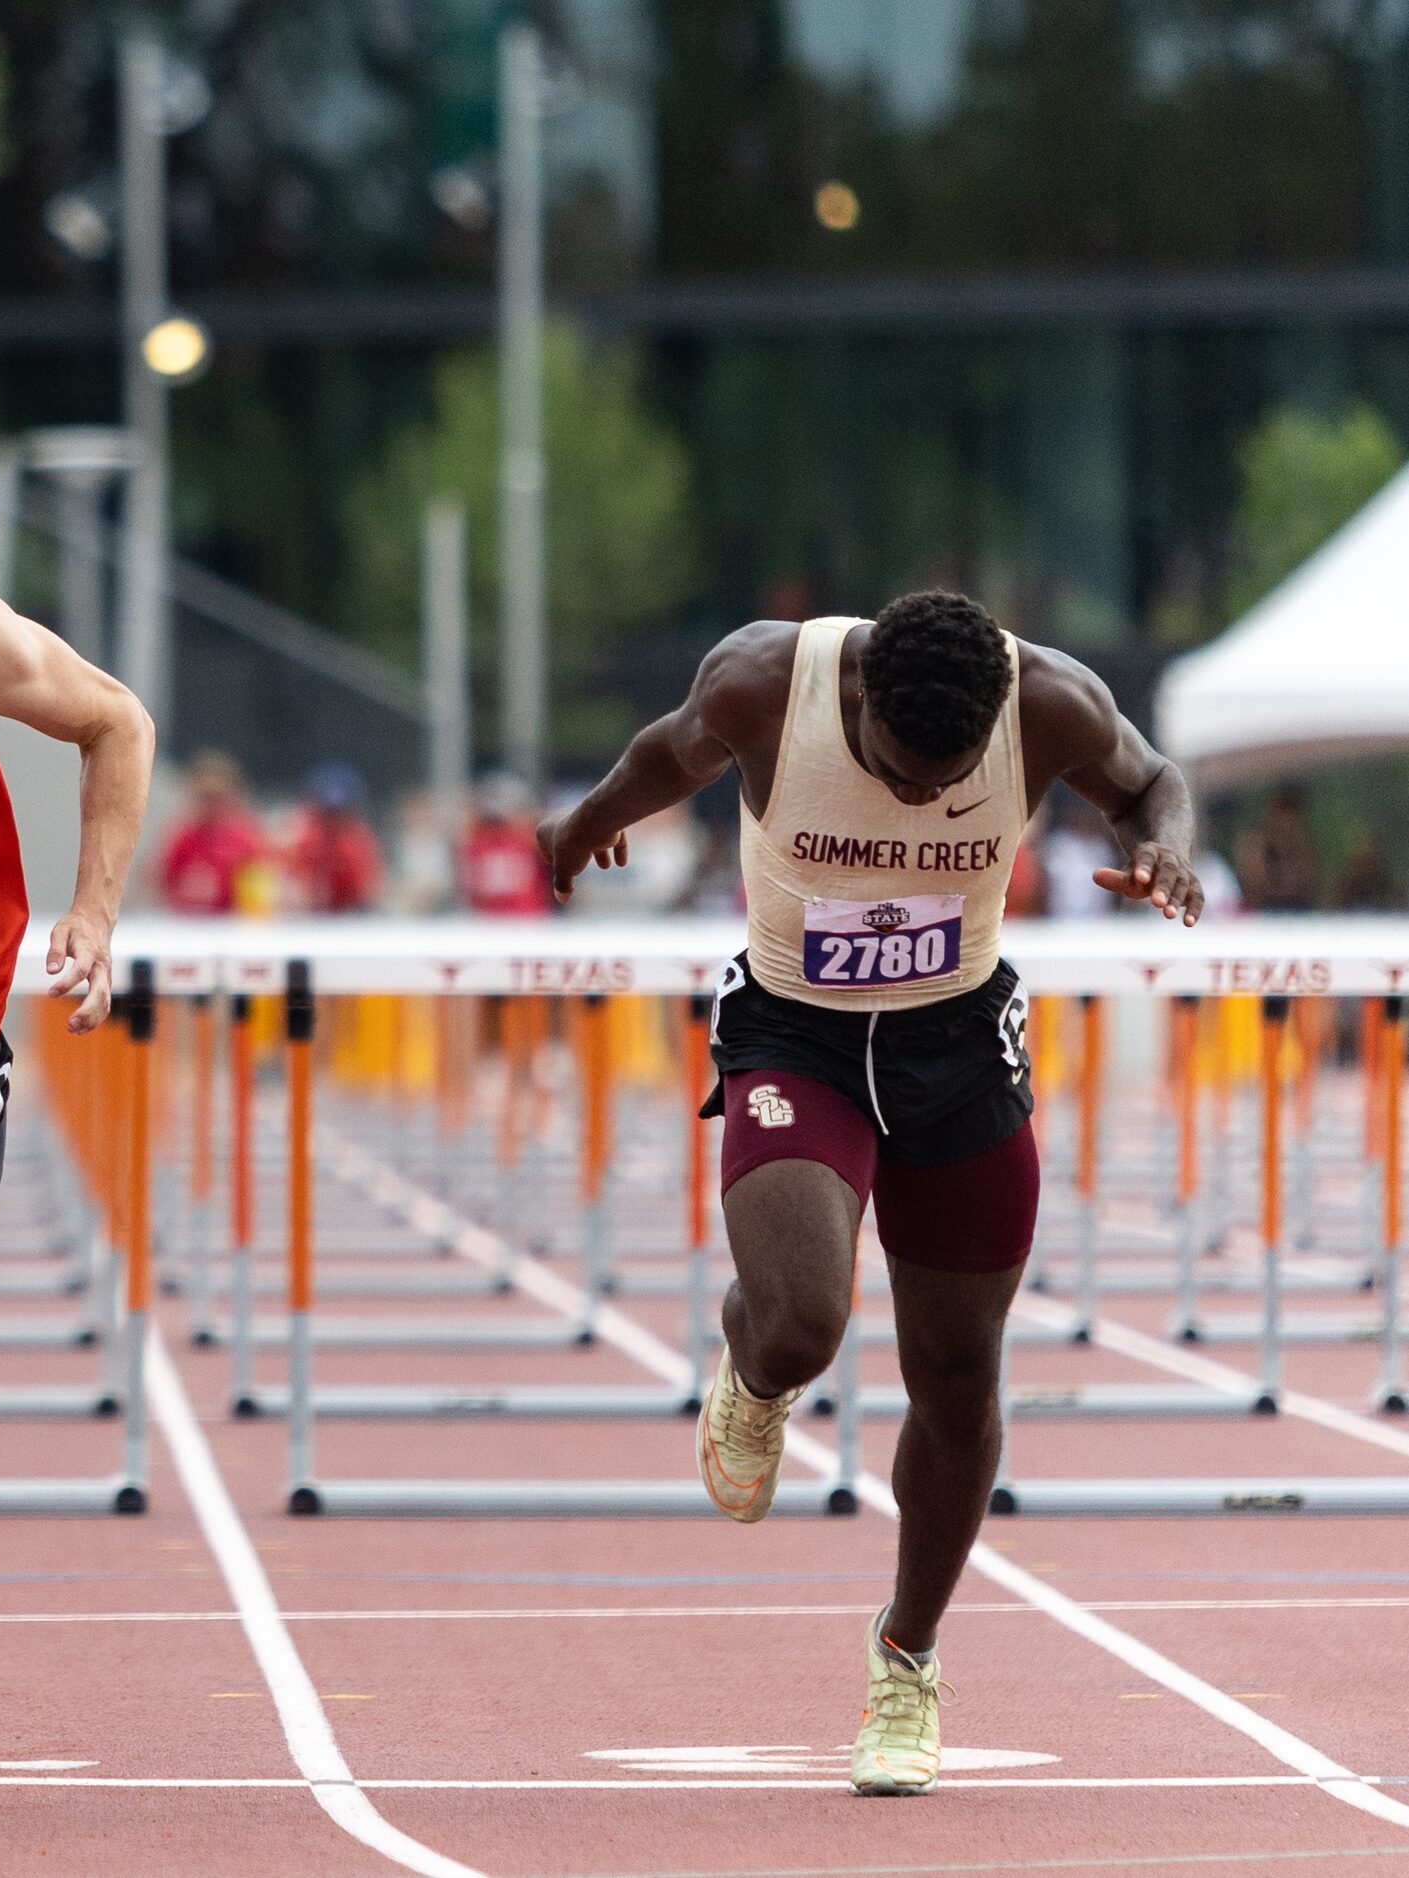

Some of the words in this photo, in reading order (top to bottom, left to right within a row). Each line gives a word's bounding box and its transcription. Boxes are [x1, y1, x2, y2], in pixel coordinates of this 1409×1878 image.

[792, 832, 906, 869] SUMMER
[917, 836, 1002, 872] CREEK
[863, 913, 910, 923] STATE
[819, 929, 946, 980] 2780
[505, 957, 635, 991] TEXAS
[1206, 957, 1334, 993] TEXAS
